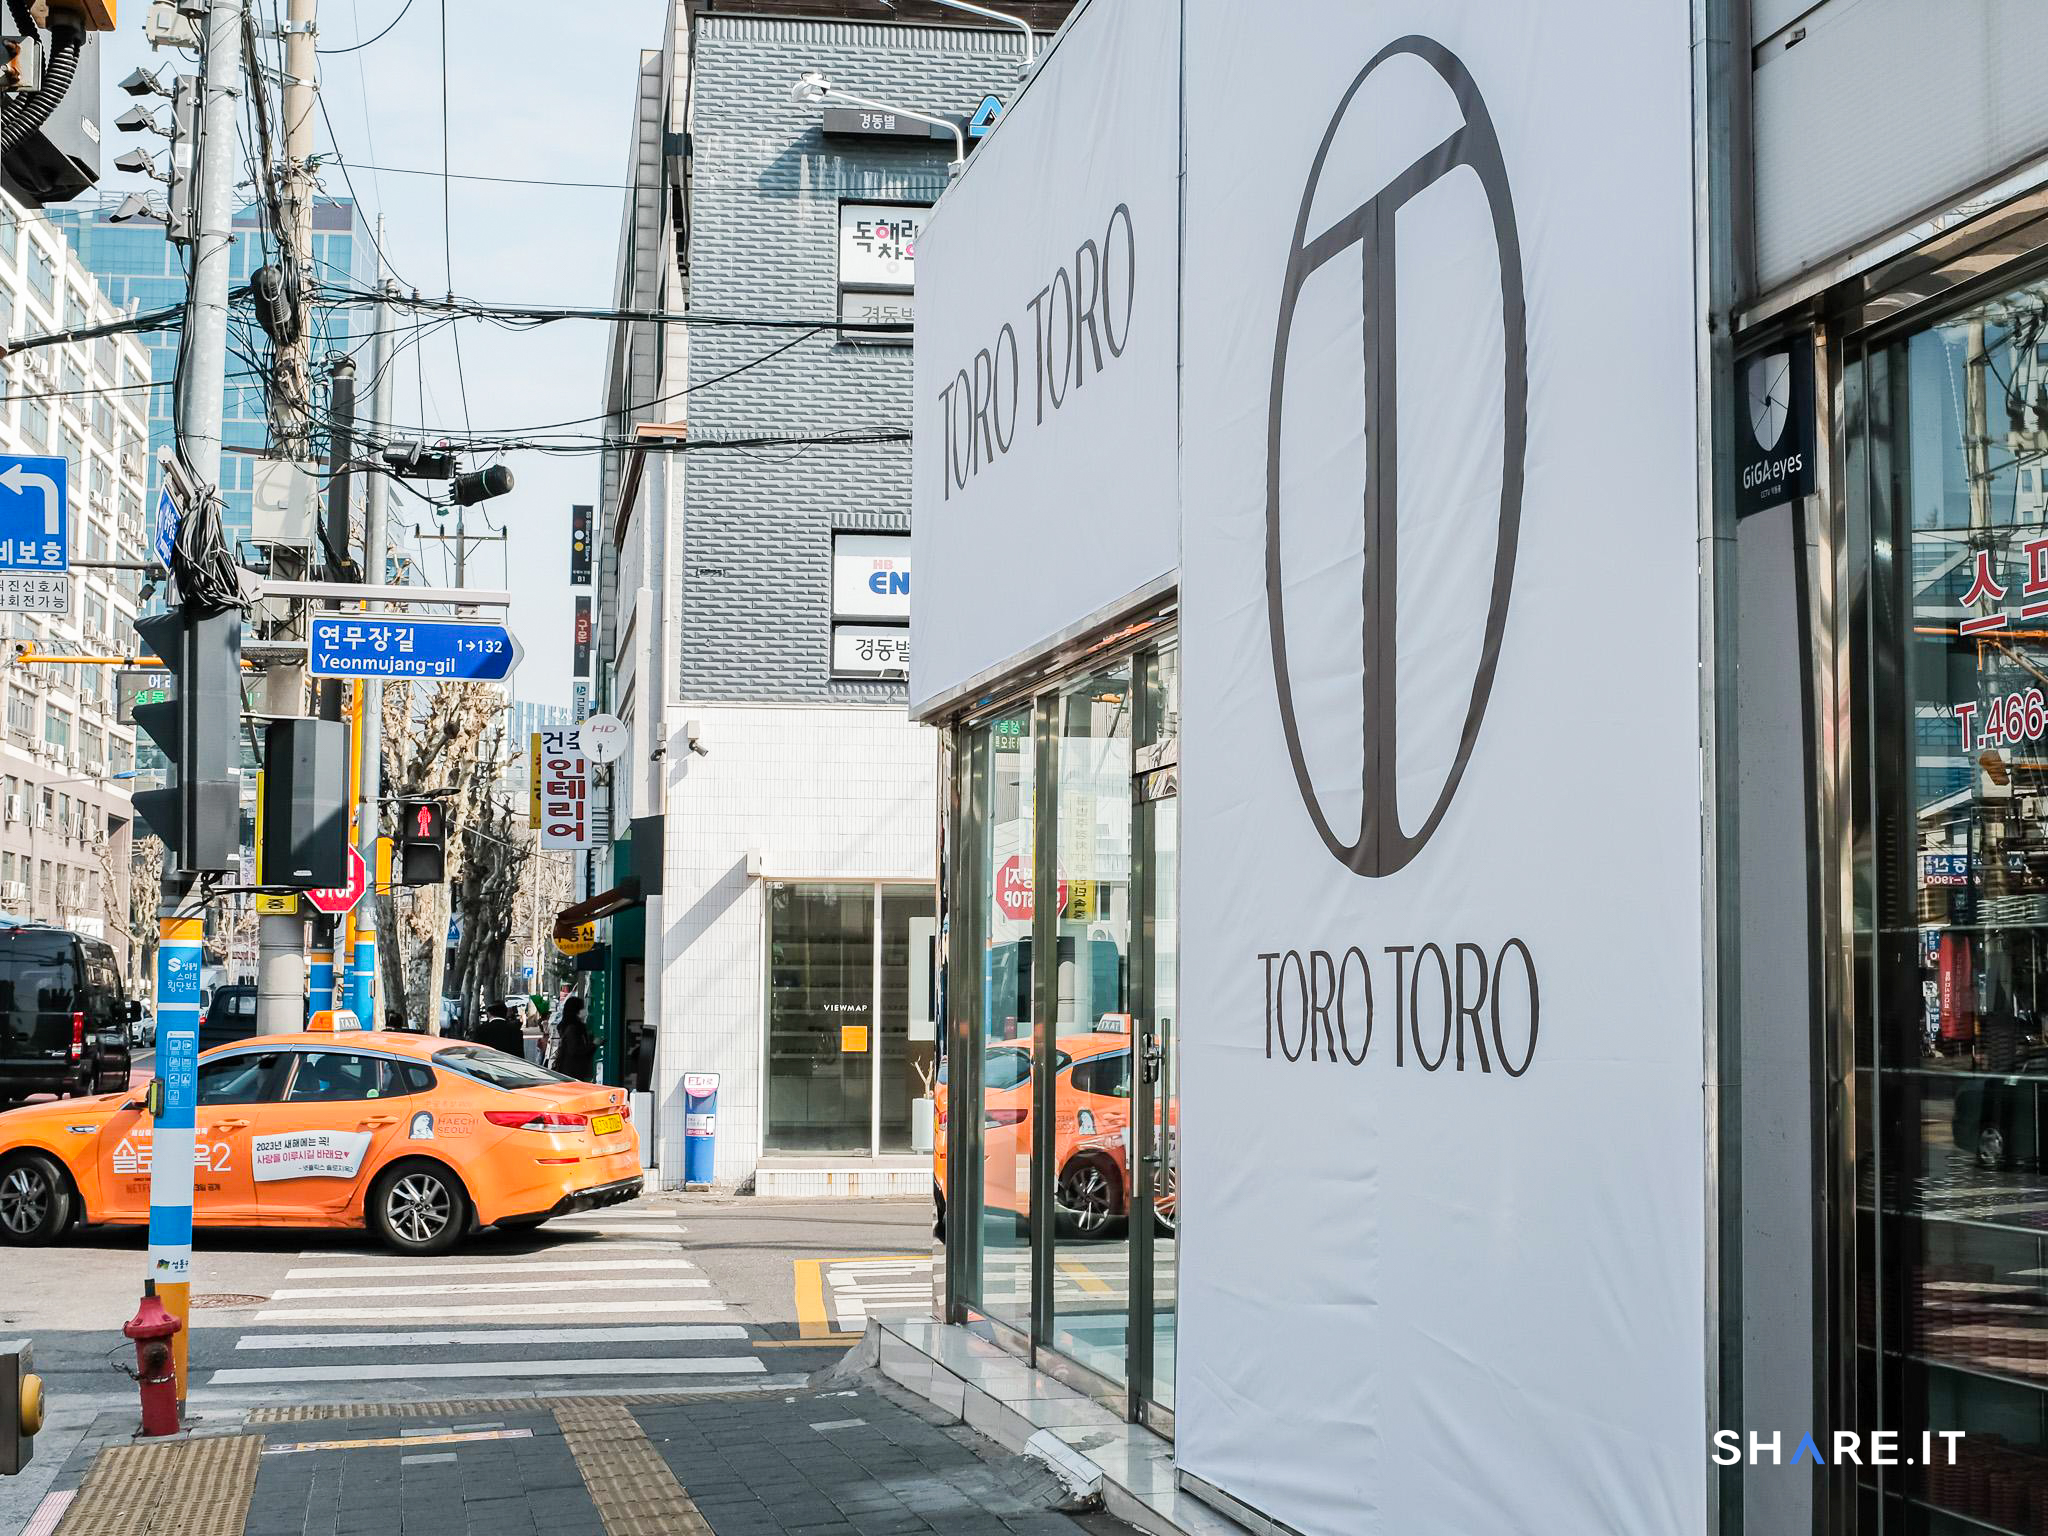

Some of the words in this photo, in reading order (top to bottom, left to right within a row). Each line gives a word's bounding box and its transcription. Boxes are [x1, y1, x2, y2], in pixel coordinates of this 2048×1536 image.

[938, 321, 1019, 502] TORO
[1026, 202, 1136, 427] TORO
[873, 559, 894, 570] HB
[318, 625, 415, 653] 연무장길
[318, 653, 456, 674] Yeonmujang-gil
[592, 725, 617, 733] HD
[546, 758, 586, 842] 인테리어
[176, 972, 198, 981] 스마트
[168, 980, 198, 993] 횡단보도
[823, 1004, 868, 1012] VIEWMAP
[1257, 946, 1373, 1066] TORO
[1384, 937, 1540, 1078] TORO
[340, 1017, 359, 1030] TAXI
[438, 1118, 480, 1126] HAECHI
[438, 1126, 473, 1135] SEOUL
[256, 1141, 282, 1151] 2023년
[284, 1137, 317, 1149] 새해에는
[257, 1154, 281, 1164] 사랑을
[282, 1150, 315, 1162] 이루시길
